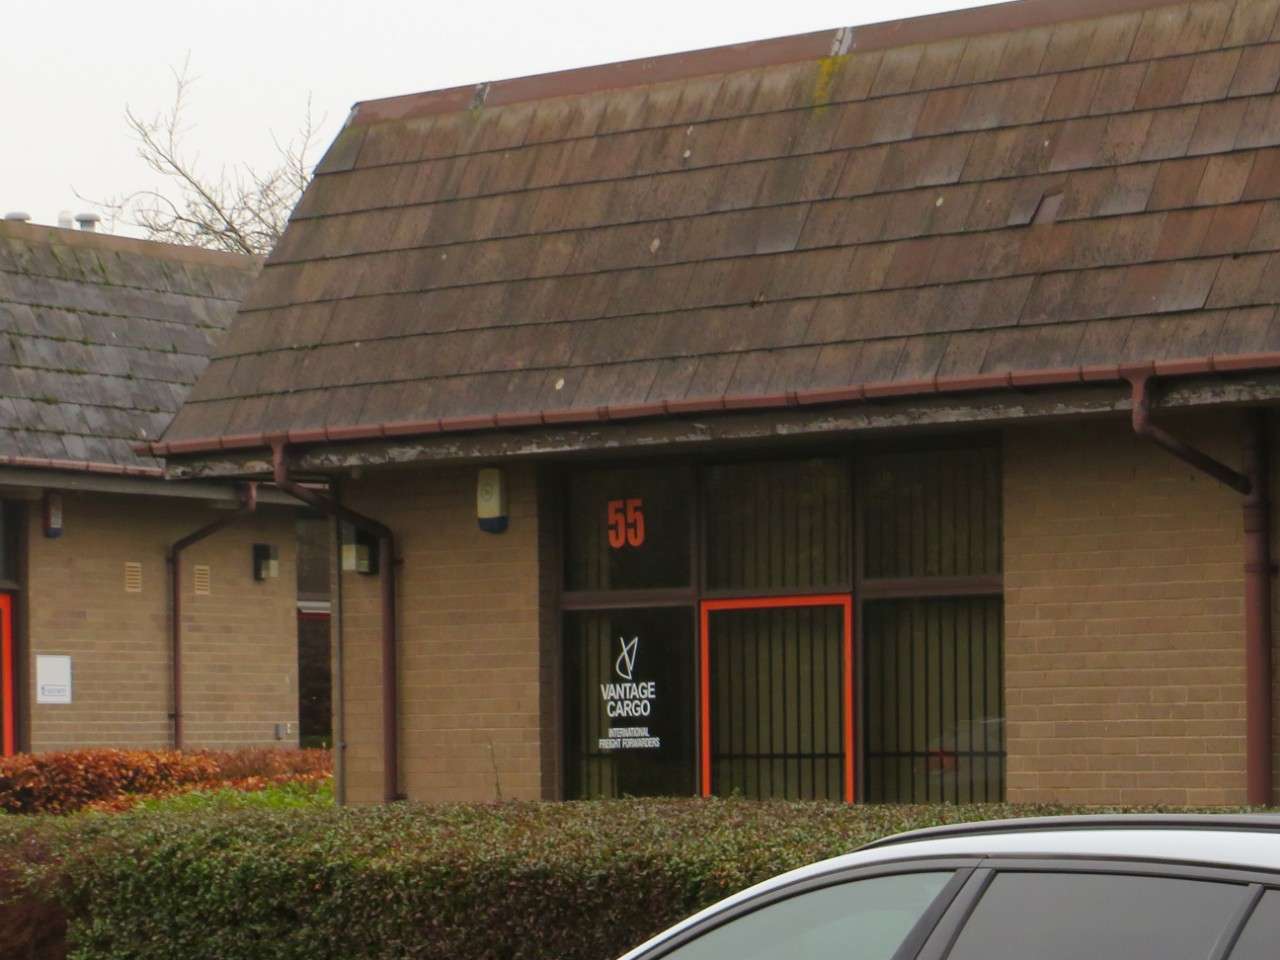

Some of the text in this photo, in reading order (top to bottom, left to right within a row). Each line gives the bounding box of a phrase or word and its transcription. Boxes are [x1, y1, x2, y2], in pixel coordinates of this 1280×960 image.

[607, 498, 646, 549] 55
[600, 681, 656, 700] VANTAGE
[606, 699, 651, 717] CARGO
